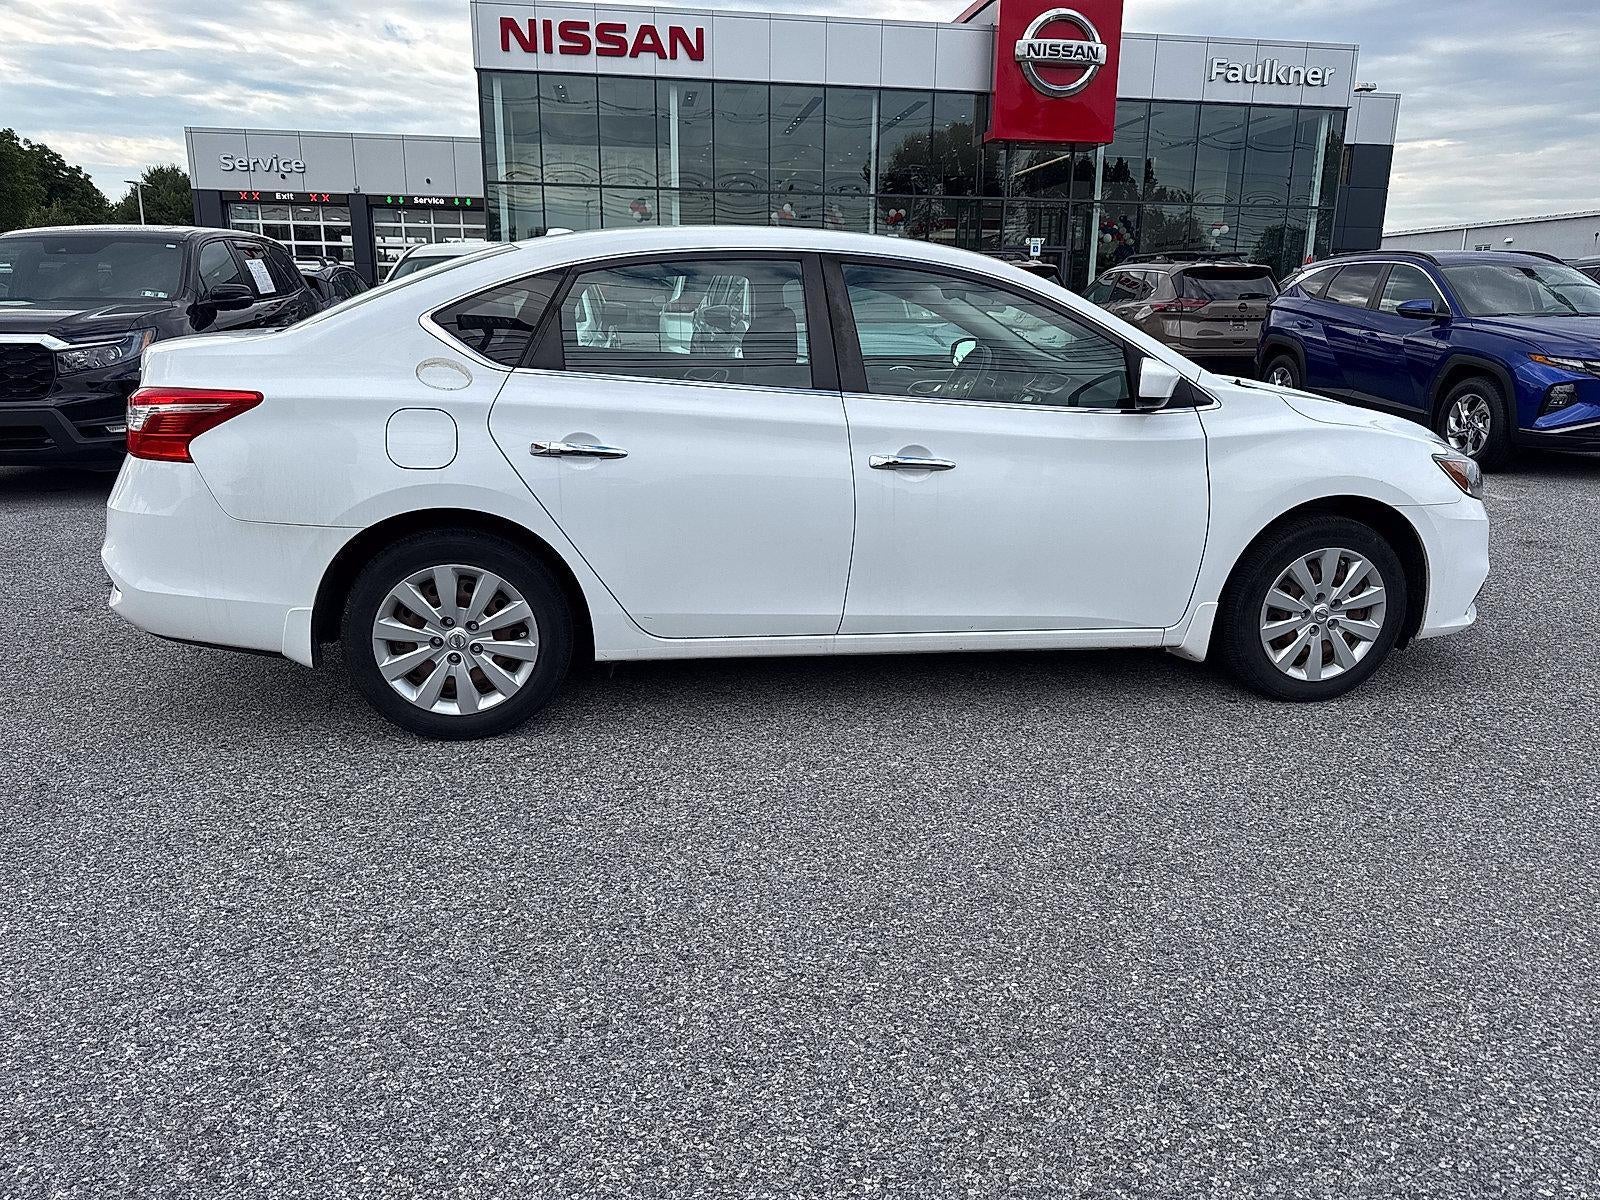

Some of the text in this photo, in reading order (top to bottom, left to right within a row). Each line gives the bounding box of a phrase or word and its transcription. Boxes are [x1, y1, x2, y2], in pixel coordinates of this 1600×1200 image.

[499, 16, 704, 61] NISSAN
[1026, 43, 1100, 60] NISSAN
[1209, 57, 1336, 86] Faulkner
[219, 153, 305, 173] Service
[275, 192, 295, 200] Exit
[413, 196, 445, 205] Service
